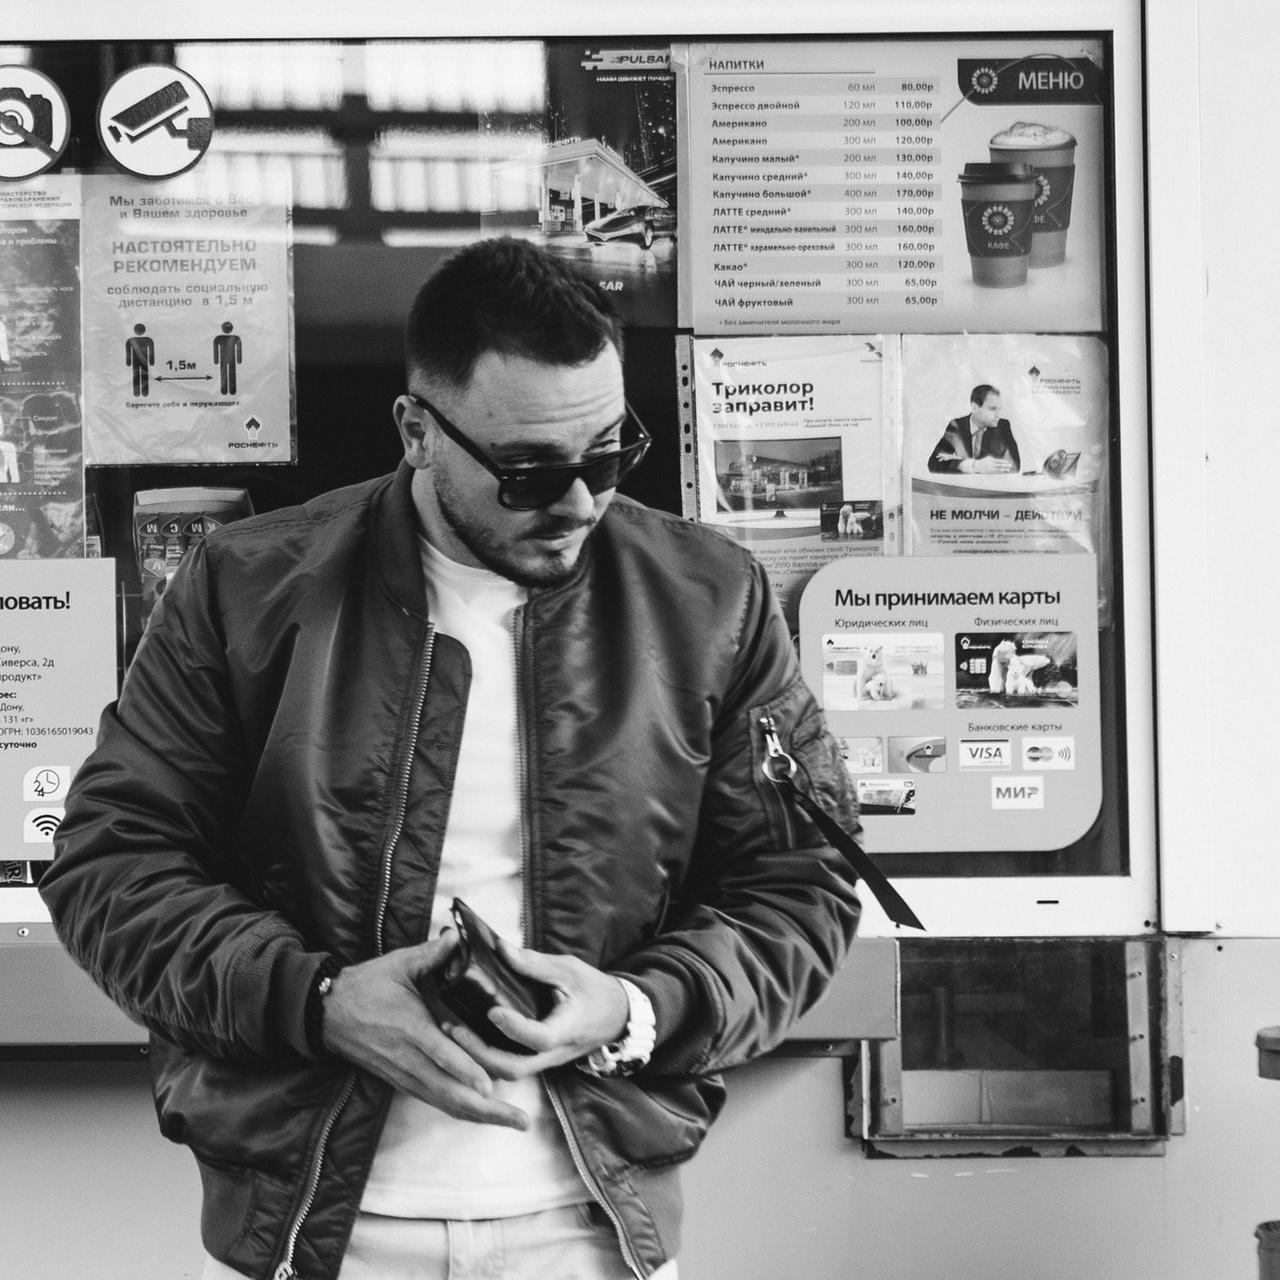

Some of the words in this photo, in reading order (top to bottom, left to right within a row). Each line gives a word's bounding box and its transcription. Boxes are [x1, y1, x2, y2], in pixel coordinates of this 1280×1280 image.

[709, 61, 764, 70] НАПИТКИ
[1019, 72, 1084, 90] МЕНЮ
[711, 84, 755, 95] Эспрессо
[848, 83, 861, 92] 60
[901, 83, 934, 93] 80,00р
[712, 102, 756, 112] Эспрессо
[757, 102, 800, 111] двойной
[844, 101, 861, 110] 120
[895, 101, 933, 110] 110,00р
[712, 120, 768, 129] Американо
[843, 118, 861, 127] 200
[863, 118, 876, 127] мл
[896, 118, 933, 128] 100,00р
[712, 138, 768, 147] Американо
[844, 136, 861, 145] 300
[896, 136, 933, 146] 120,00р
[712, 155, 760, 165] Капучино
[844, 154, 862, 163] 200
[896, 154, 934, 163] 130,00р
[713, 174, 760, 183] Капучино
[844, 172, 862, 180] 300
[897, 172, 934, 181] 140,00р
[713, 191, 761, 200] Капучино
[844, 189, 863, 200] 400
[864, 190, 877, 198] мл
[897, 189, 934, 199] 170,00р
[110, 196, 134, 206] Мы
[140, 196, 212, 207] заботимся
[133, 209, 180, 218] Вашем
[185, 209, 248, 220] здоровье
[713, 208, 743, 216] ЛАТТЕ
[845, 207, 863, 216] 300
[897, 207, 934, 217] 140,00р
[750, 225, 837, 234] миндально-ванильный
[845, 222, 863, 234] 300
[864, 224, 878, 233] мл
[897, 225, 935, 235] 160,00р
[112, 240, 256, 254] НАСТОЯТЕЛЬНО
[751, 243, 835, 253] карамельно-ореховый
[845, 243, 863, 251] 300
[898, 243, 935, 252] 160,00р
[113, 258, 256, 274] РЕКОМЕНДУЕМ
[846, 260, 864, 269] 300
[865, 261, 879, 269] мл
[898, 260, 936, 270] 120,00р
[107, 285, 181, 296] соблюдать
[185, 283, 268, 295] социальную
[714, 279, 735, 288] ЧАЙ
[737, 279, 821, 289] черный/зеленый
[846, 279, 864, 287] 300
[905, 279, 937, 288] 65,00р
[117, 297, 193, 309] дистанцию
[202, 298, 210, 306] в
[215, 295, 238, 307] 1,5
[244, 296, 254, 304] м
[715, 298, 736, 307] ЧАЙ
[738, 298, 793, 309] фруктовый
[847, 296, 864, 305] 300
[905, 297, 938, 306] 65,00р
[166, 360, 197, 372] 1,5м
[712, 382, 814, 400] Триколор
[713, 397, 814, 416] заправит!
[930, 510, 947, 520] НЕ
[951, 510, 1000, 520] МОЛЧИ
[835, 589, 871, 606] Мы
[875, 592, 994, 611] принимаем
[999, 592, 1061, 609] карты
[835, 619, 906, 629] Юридических
[909, 620, 928, 628] лиц
[974, 618, 1037, 626] Физических
[1039, 619, 1059, 627] лиц
[43, 658, 55, 668] 2д
[3, 715, 18, 724] 131
[968, 723, 1029, 732] Банковские
[1031, 724, 1062, 733] карты
[969, 748, 1002, 759] VISA
[996, 787, 1039, 799] МИР
